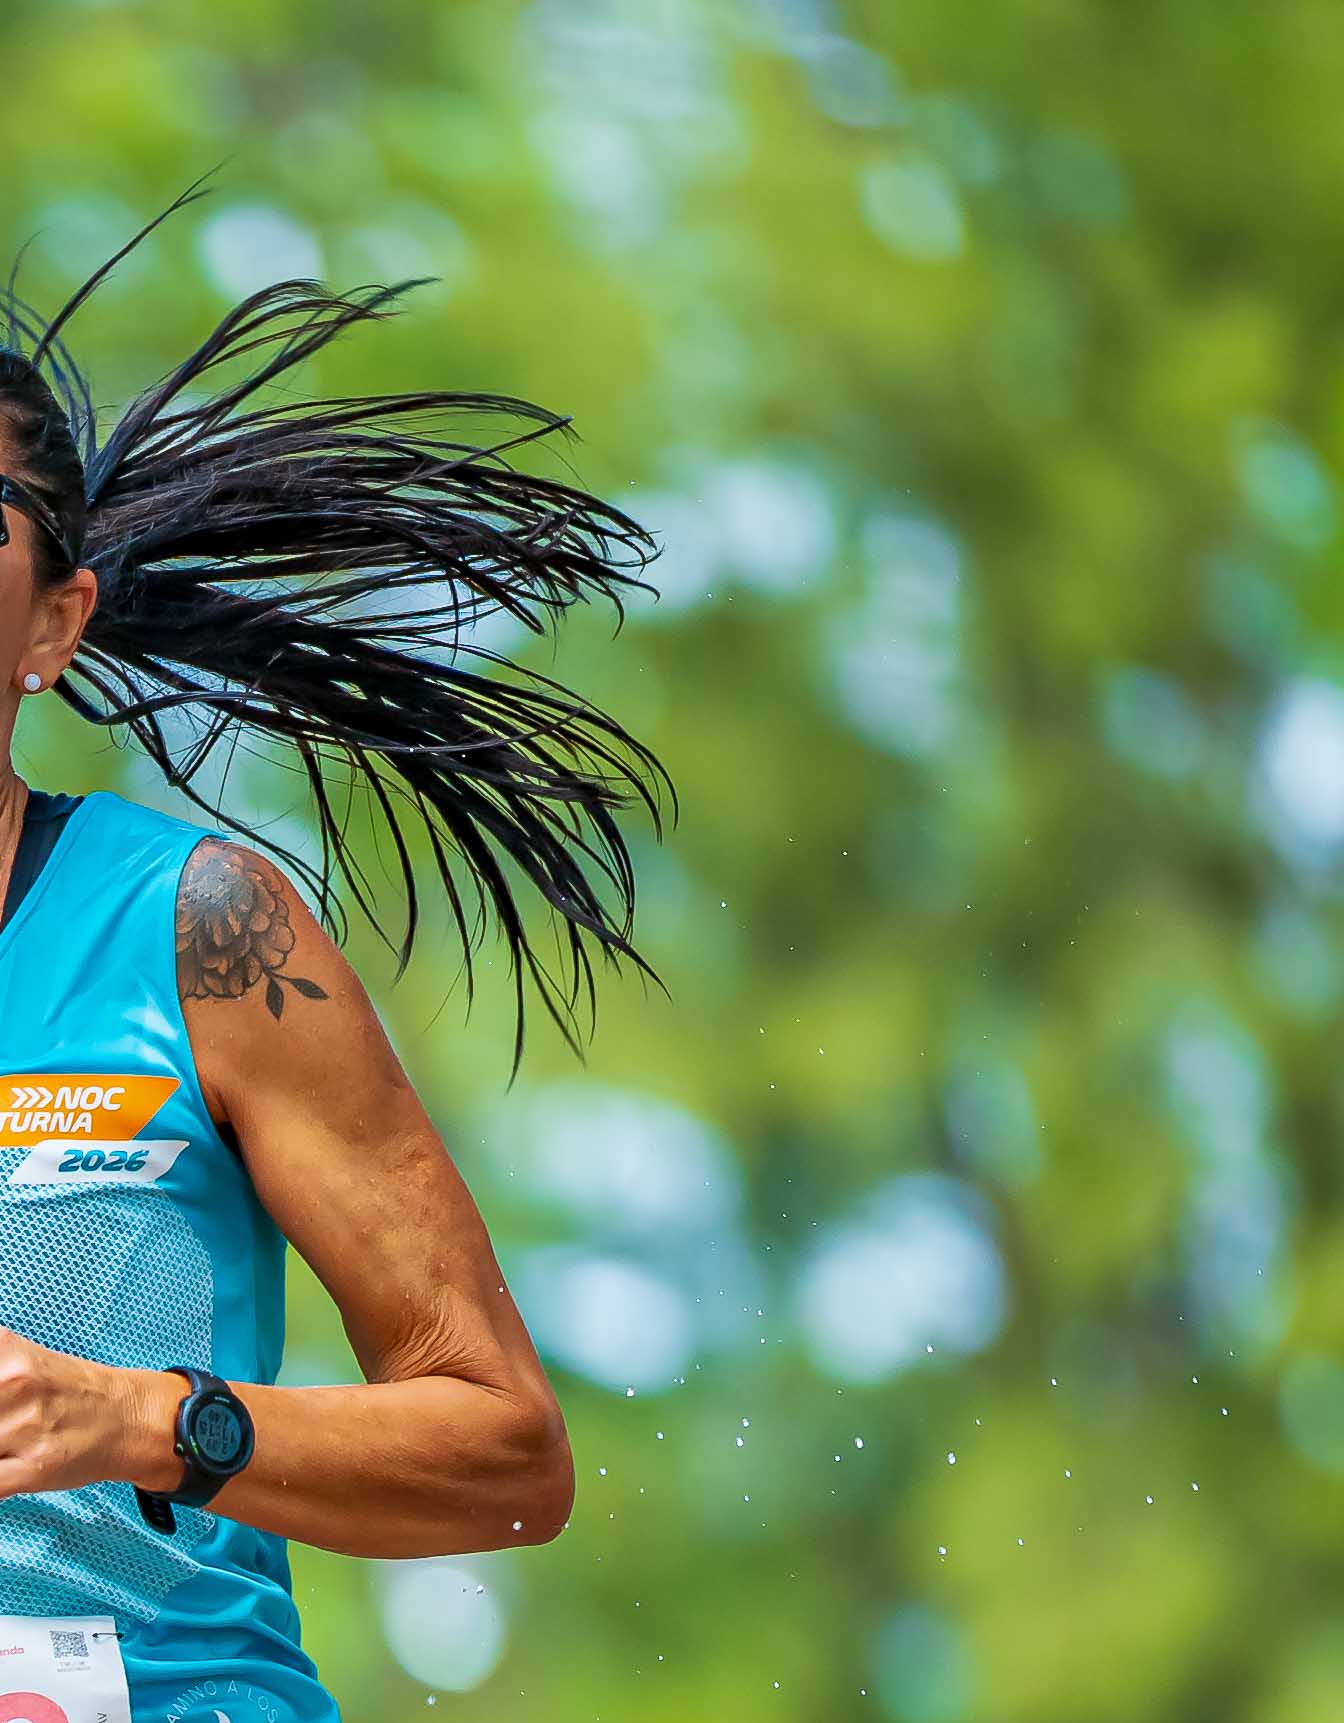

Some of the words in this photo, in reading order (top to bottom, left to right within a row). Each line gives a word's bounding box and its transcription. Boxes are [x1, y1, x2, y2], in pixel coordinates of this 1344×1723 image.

[53, 1086, 125, 1110] NOC
[58, 1149, 150, 1172] 2026
[227, 1679, 239, 1694] A
[247, 1687, 279, 1723] LOS
